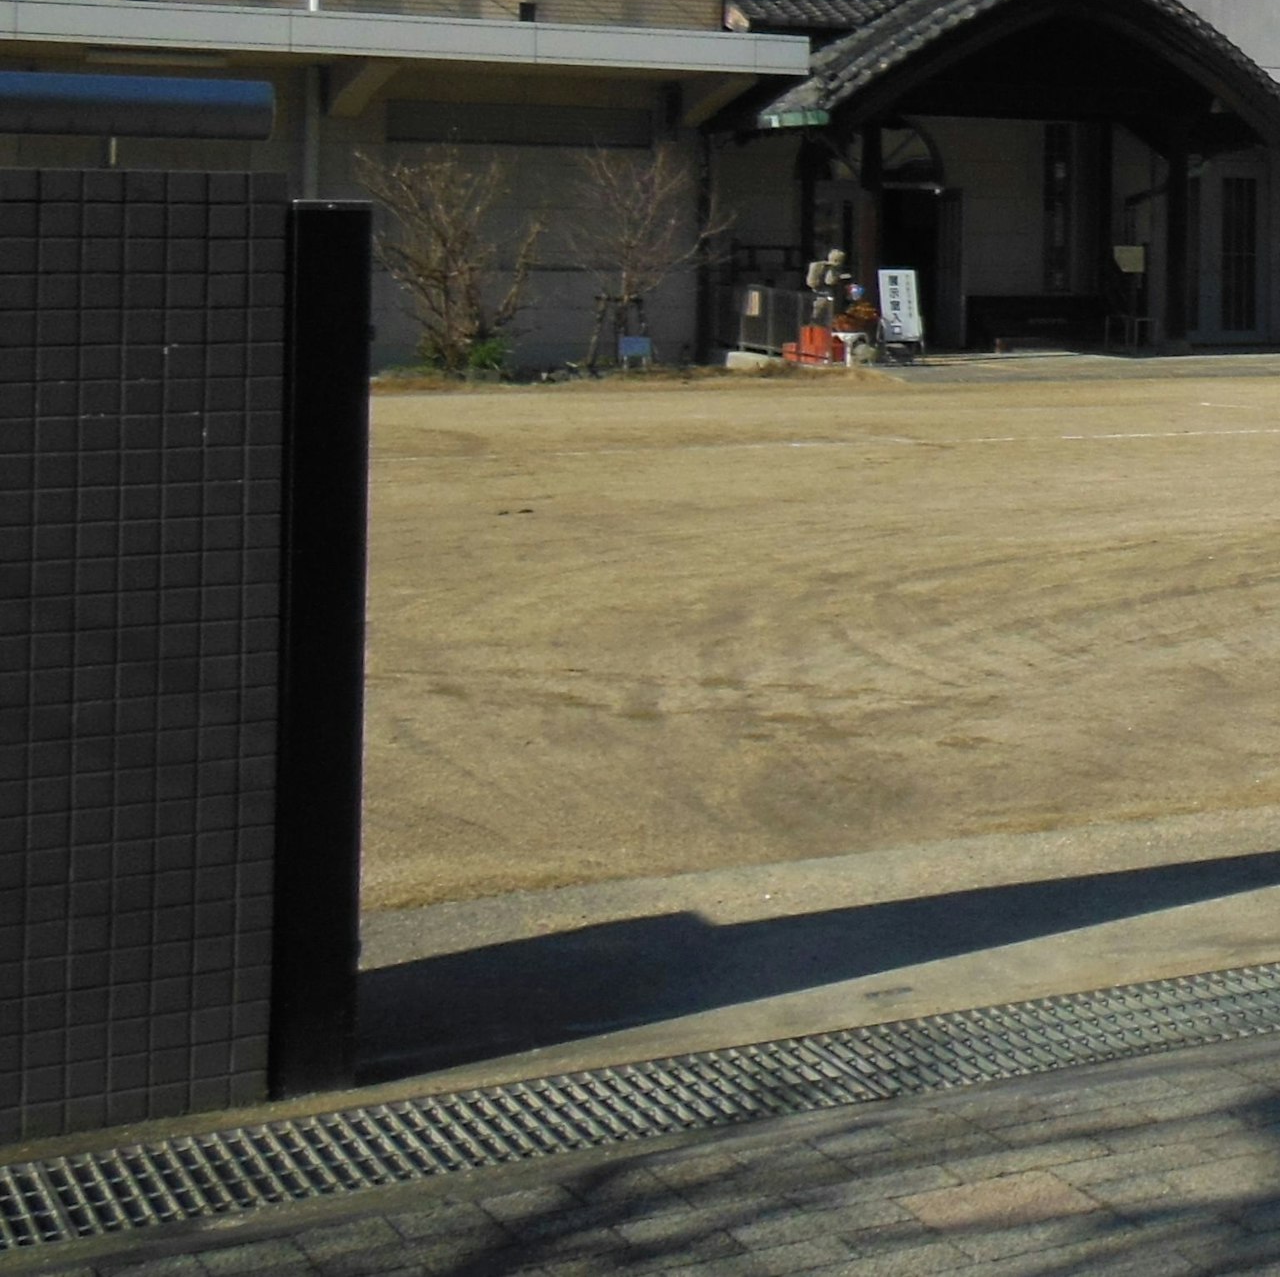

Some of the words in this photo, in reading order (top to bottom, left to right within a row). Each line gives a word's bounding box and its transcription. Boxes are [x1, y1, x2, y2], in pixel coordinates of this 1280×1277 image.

[888, 275, 902, 335] 展示室入口
